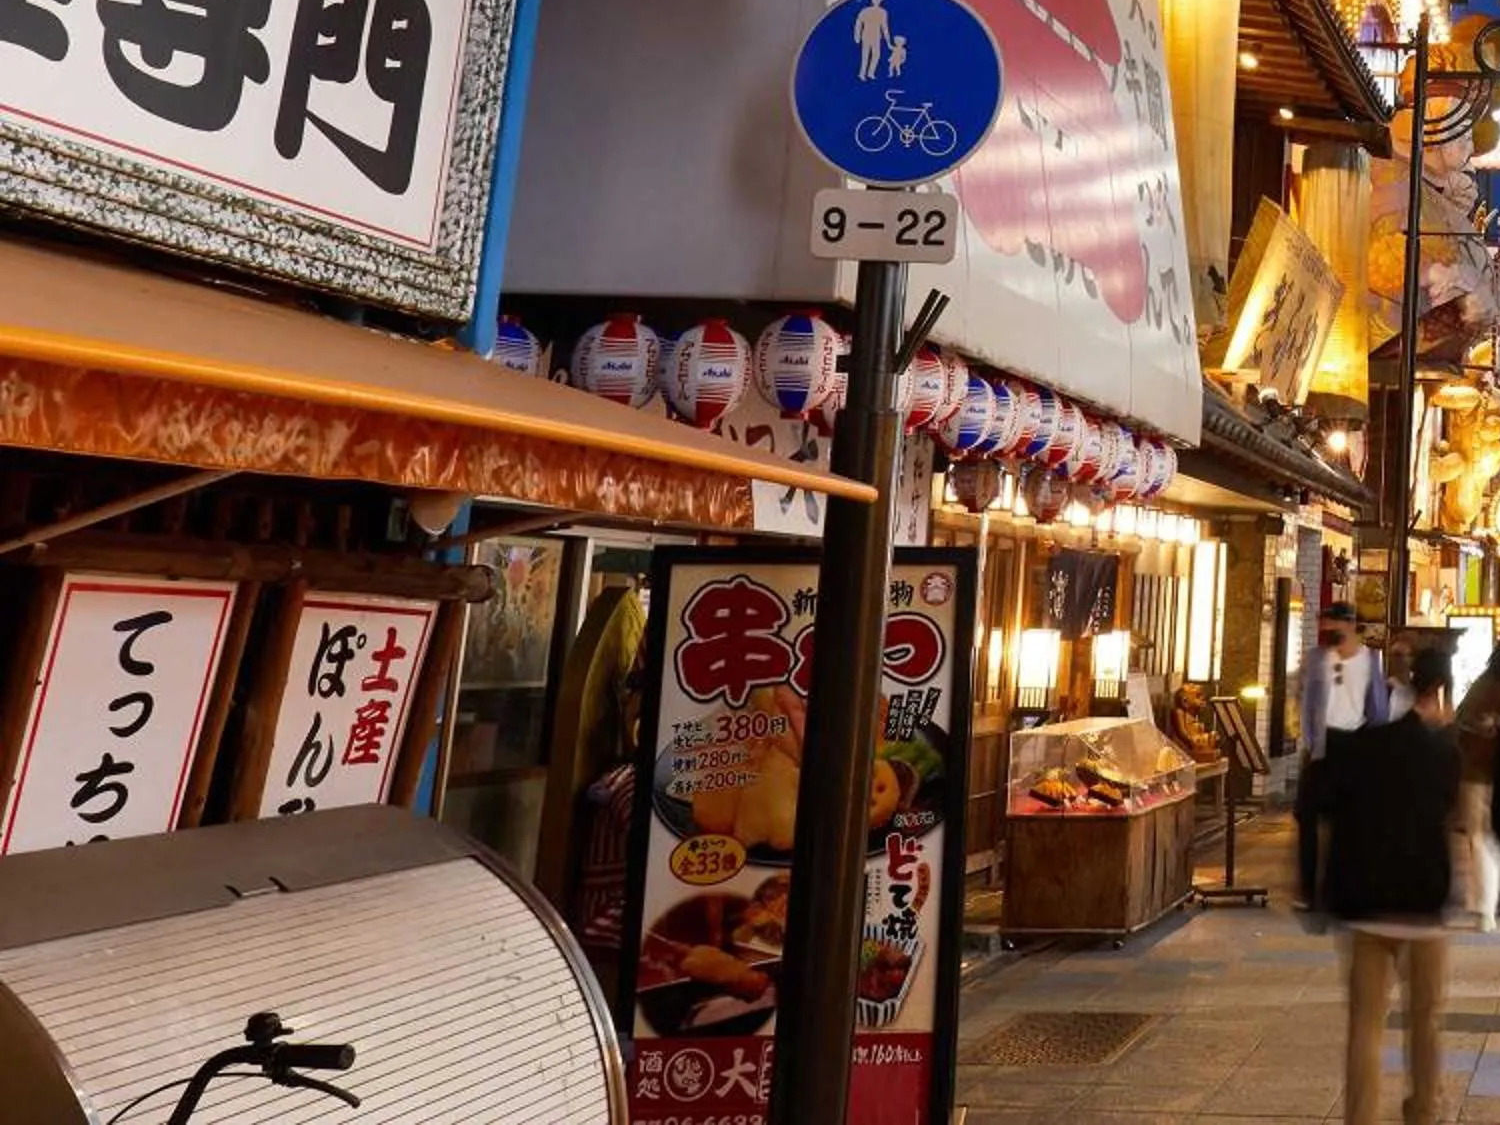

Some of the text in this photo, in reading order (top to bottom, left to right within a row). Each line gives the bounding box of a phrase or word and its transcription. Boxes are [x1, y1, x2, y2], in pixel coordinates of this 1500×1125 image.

[65, 609, 173, 851] てっち
[276, 621, 368, 820] ぽん
[341, 627, 406, 768] 土産
[716, 712, 787, 744] 380円
